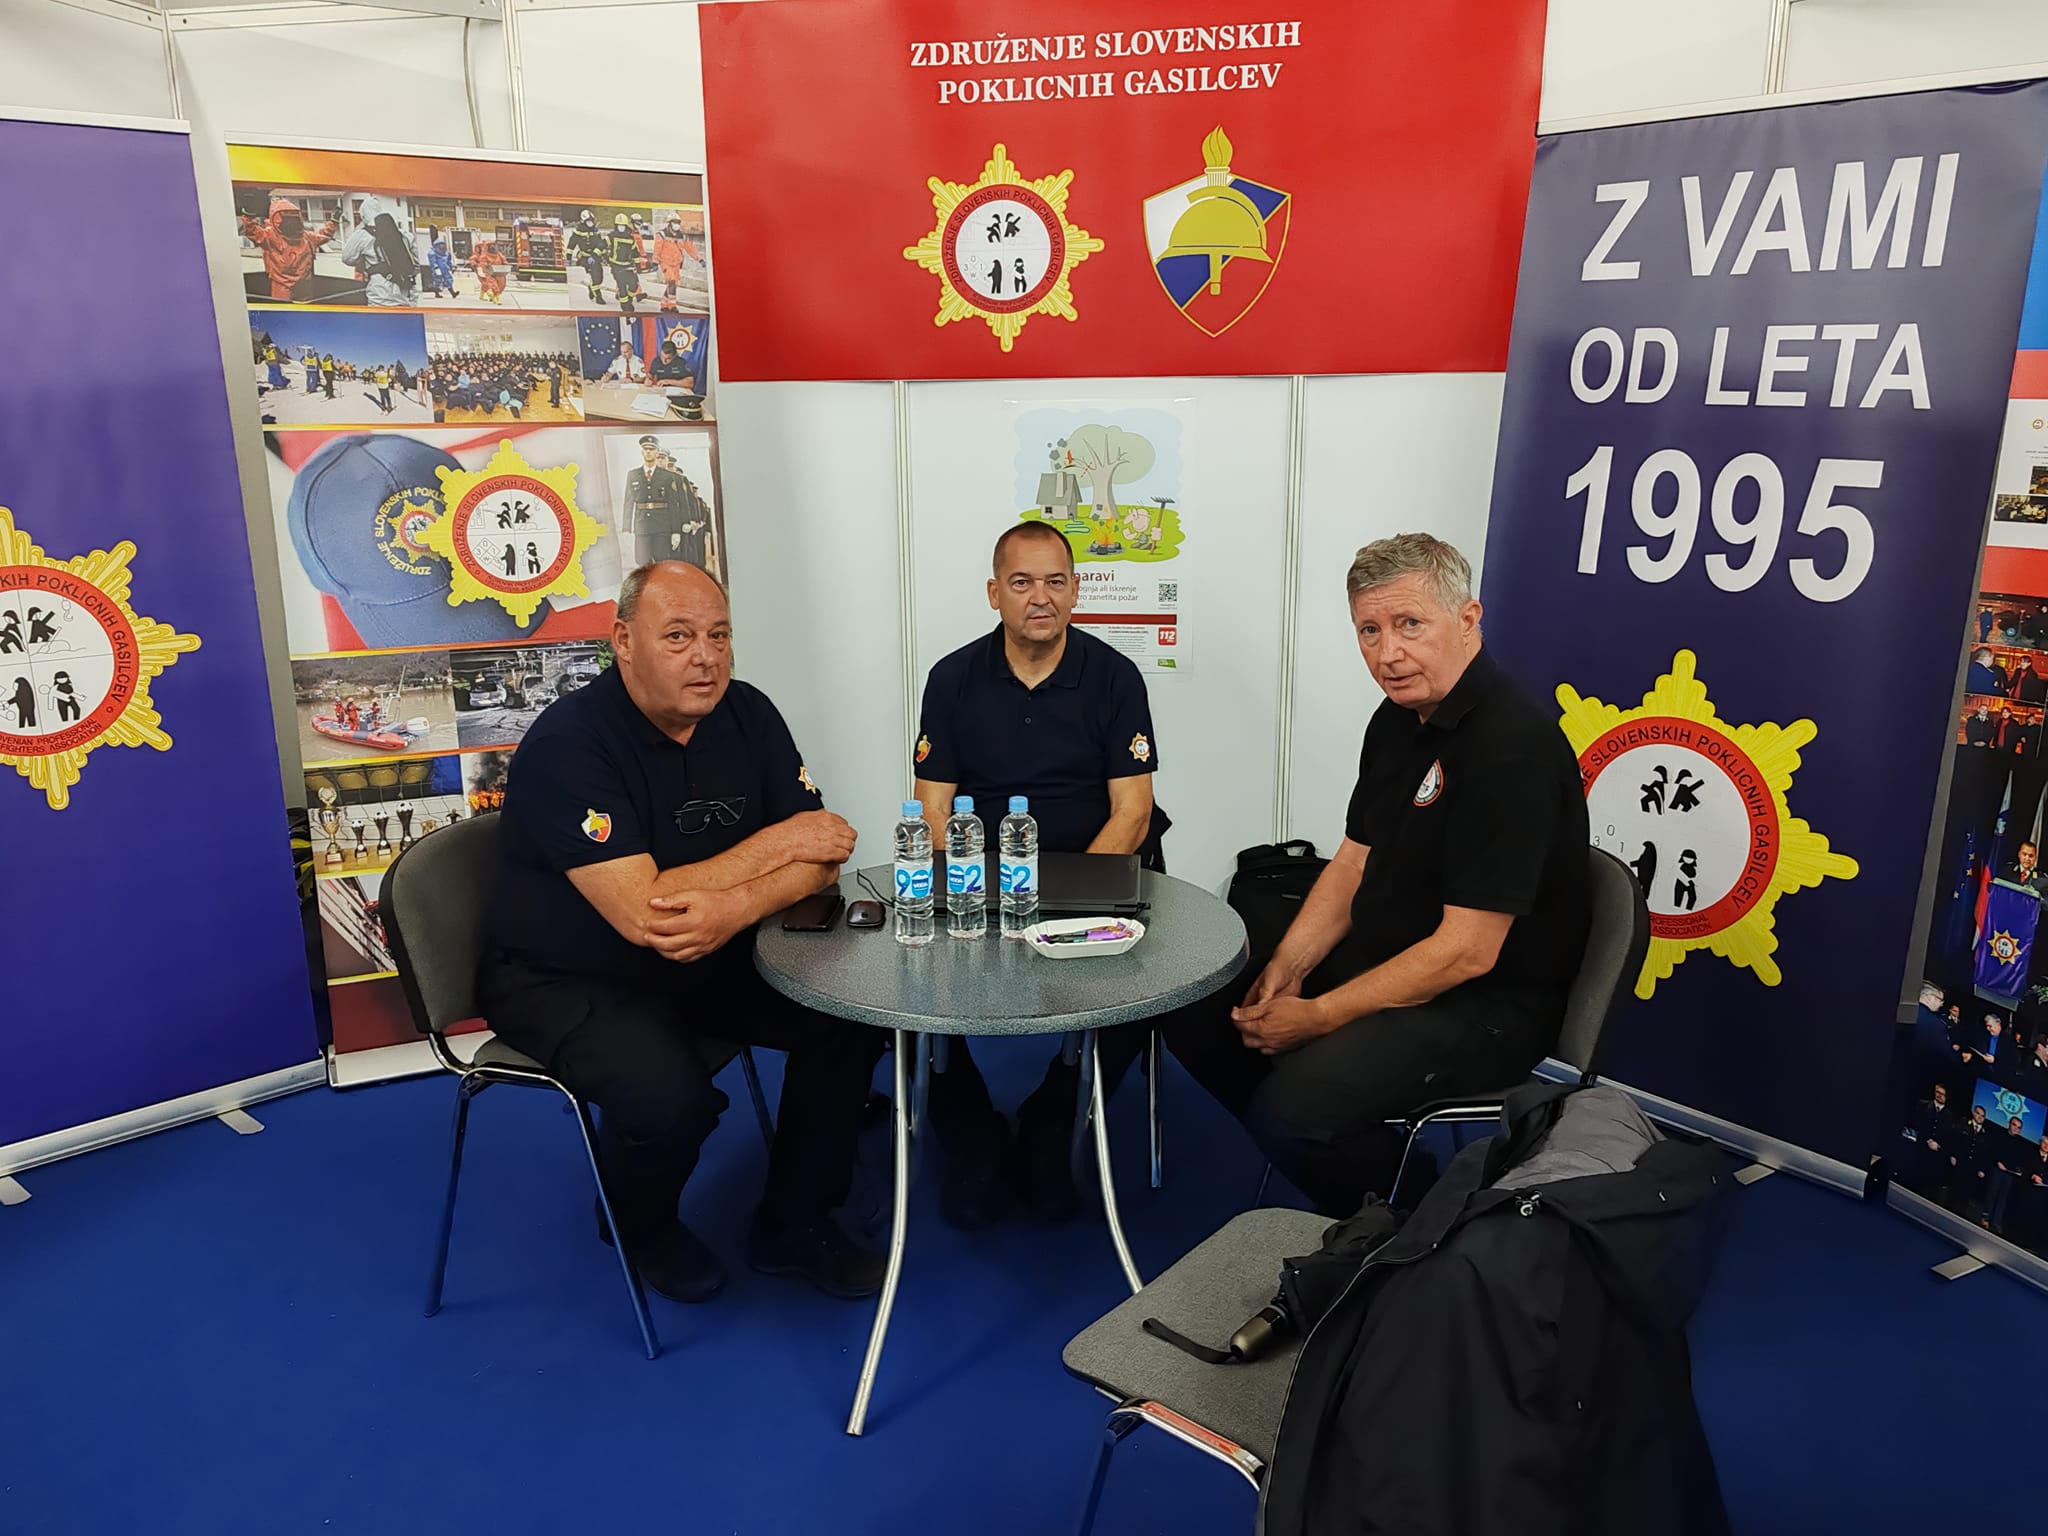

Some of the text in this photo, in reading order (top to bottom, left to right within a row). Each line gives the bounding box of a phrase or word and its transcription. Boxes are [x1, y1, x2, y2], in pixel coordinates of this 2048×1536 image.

[910, 21, 1302, 67] ZDRUŽENJE SLOVENSKIH
[938, 62, 1283, 105] POKLICNIH GASILCEV
[954, 190, 1010, 222] SLOVENSKIH
[1014, 190, 1055, 230] POKLICNIH
[1581, 152, 1960, 281] Z VAMI
[1570, 323, 1932, 410] OD LETA
[1565, 446, 1885, 603] 1995
[36, 574, 118, 628] POKLICNIH
[111, 630, 132, 703] GASILCEV
[1160, 631, 1175, 640] 112
[49, 722, 102, 751] ASSOCIATION
[1590, 725, 1771, 909] SLOVENSKIH POKLICNIH GASILCEV
